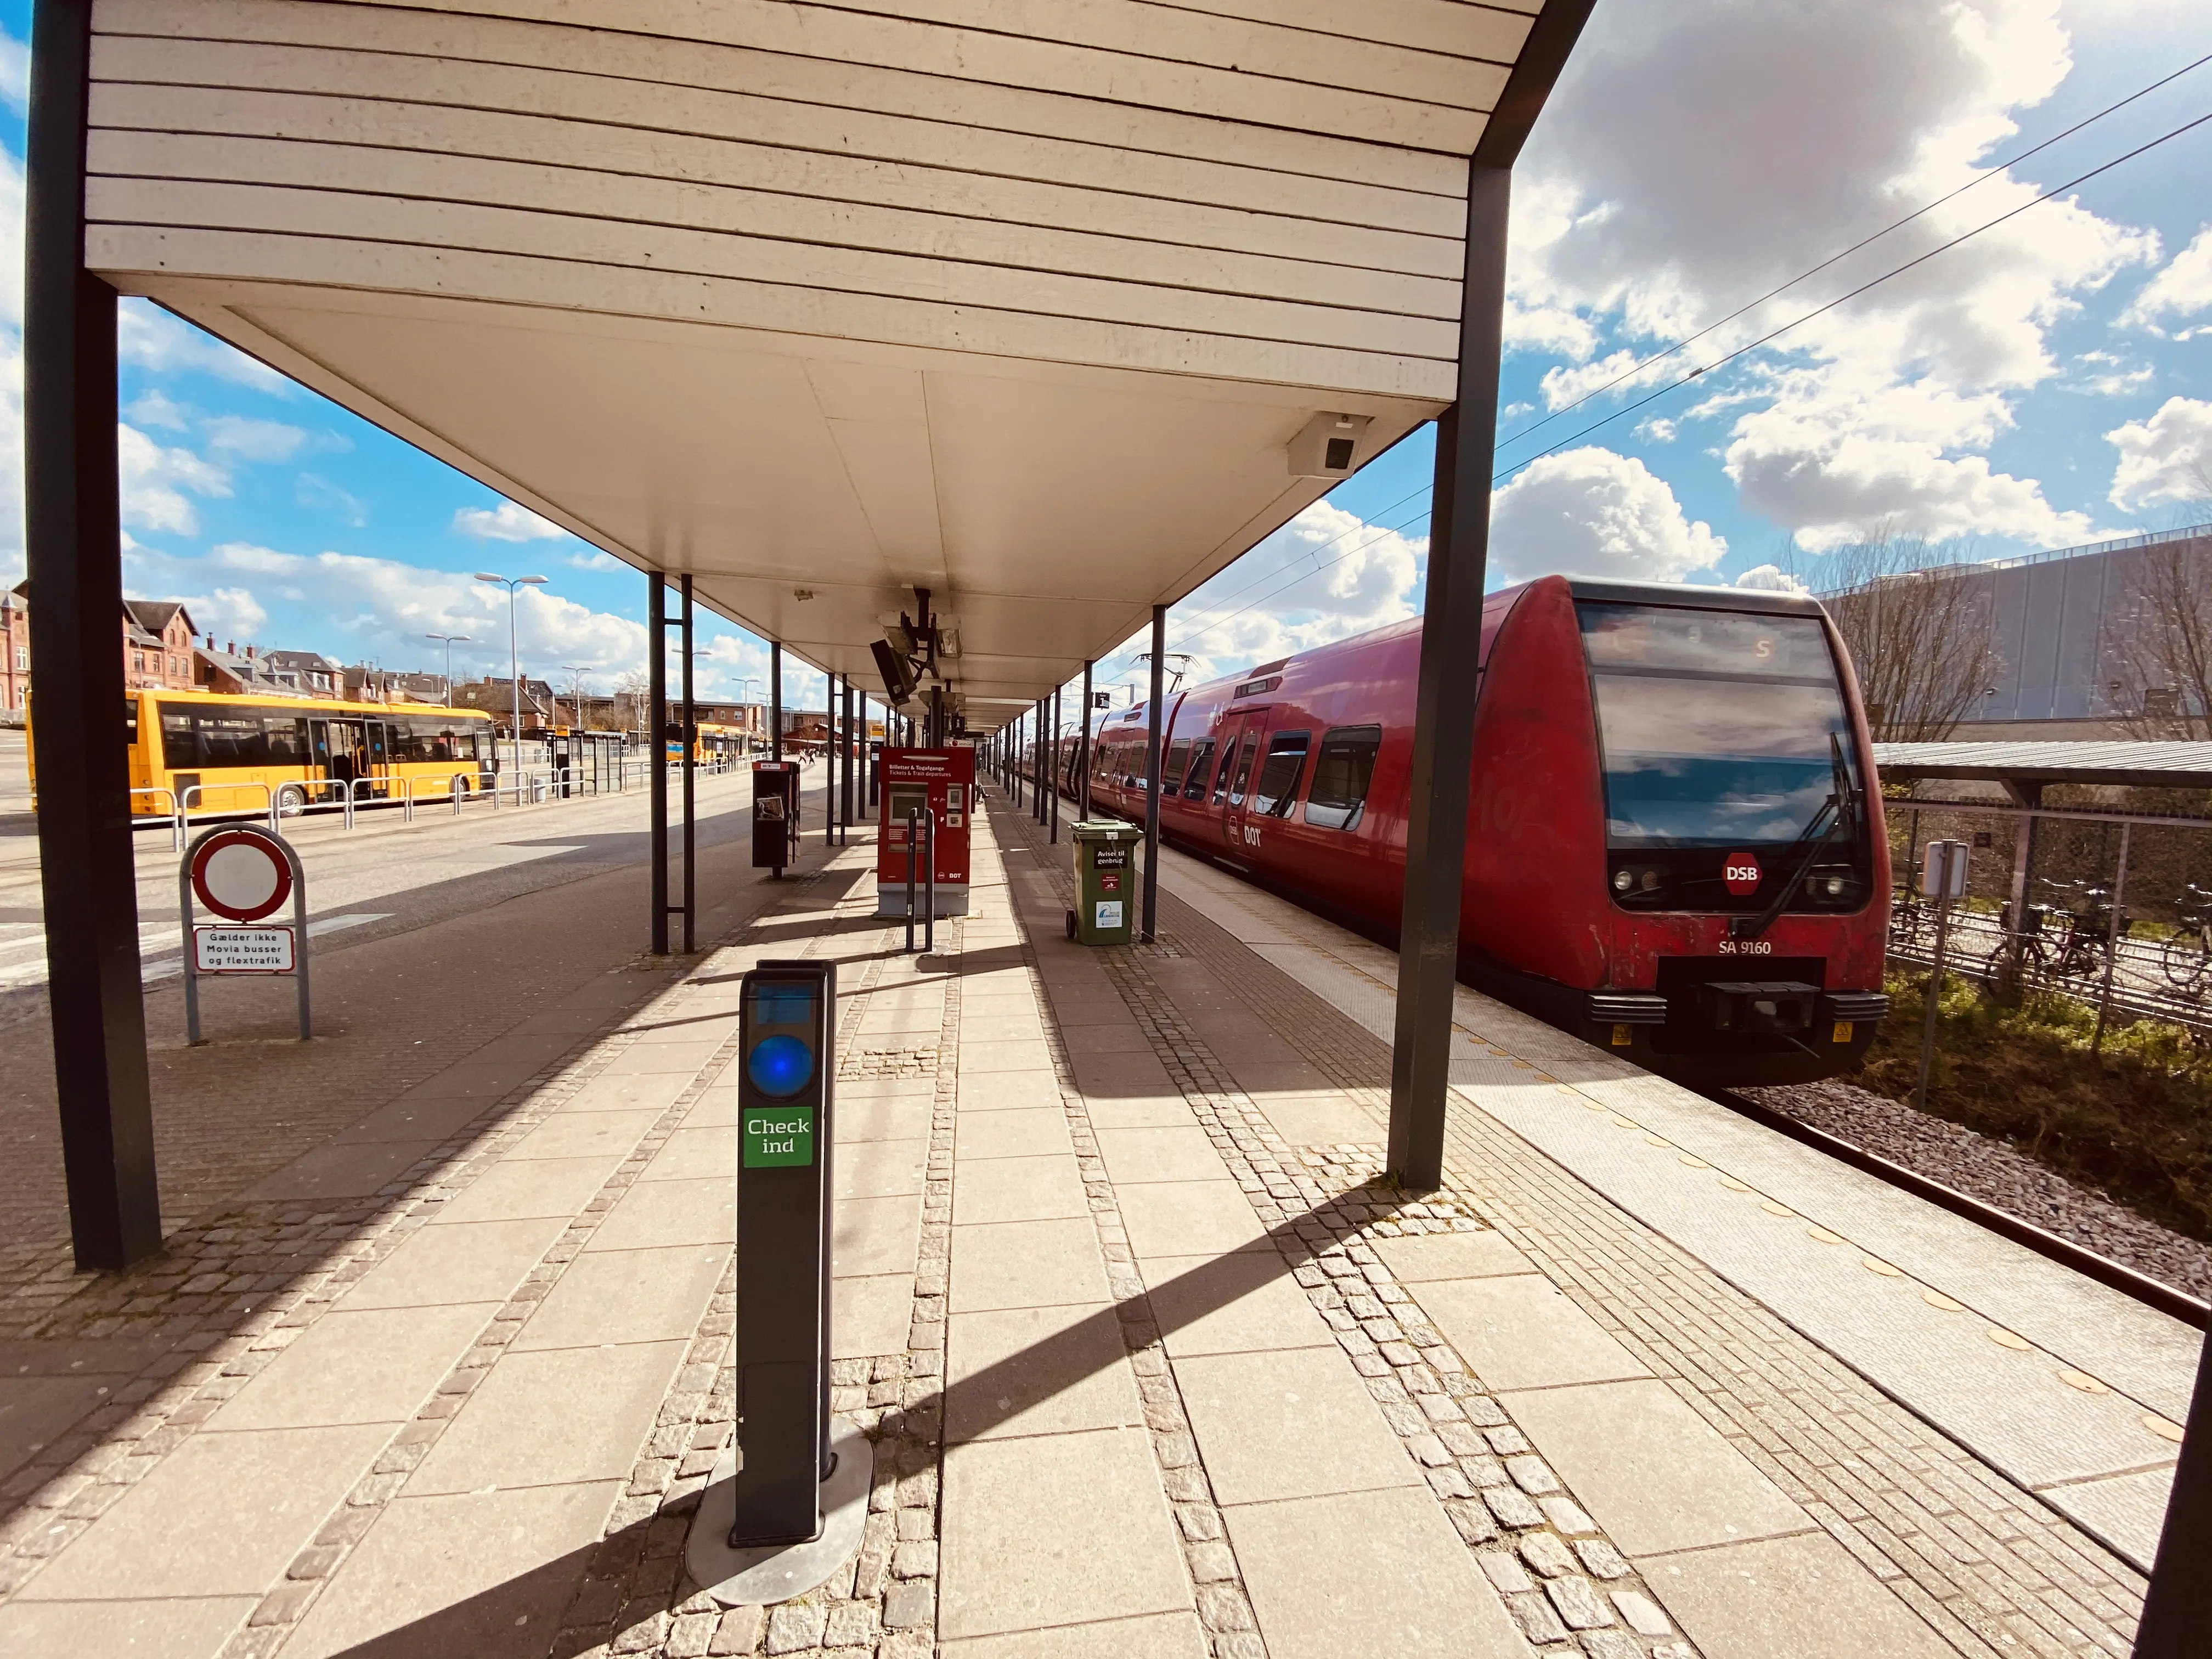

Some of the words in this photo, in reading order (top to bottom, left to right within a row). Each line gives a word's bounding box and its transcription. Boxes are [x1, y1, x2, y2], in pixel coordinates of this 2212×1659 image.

[1244, 826, 1261, 847] DOT
[1726, 866, 1758, 881] DSB
[210, 933, 250, 941] Gælder
[255, 933, 277, 941] ikke
[244, 945, 281, 953] busser
[1719, 941, 1736, 953] SA
[1741, 941, 1771, 954] 9160
[208, 957, 222, 966] og
[227, 956, 281, 964] flextrafik
[748, 1118, 810, 1135] Check
[762, 1137, 795, 1154] ind
